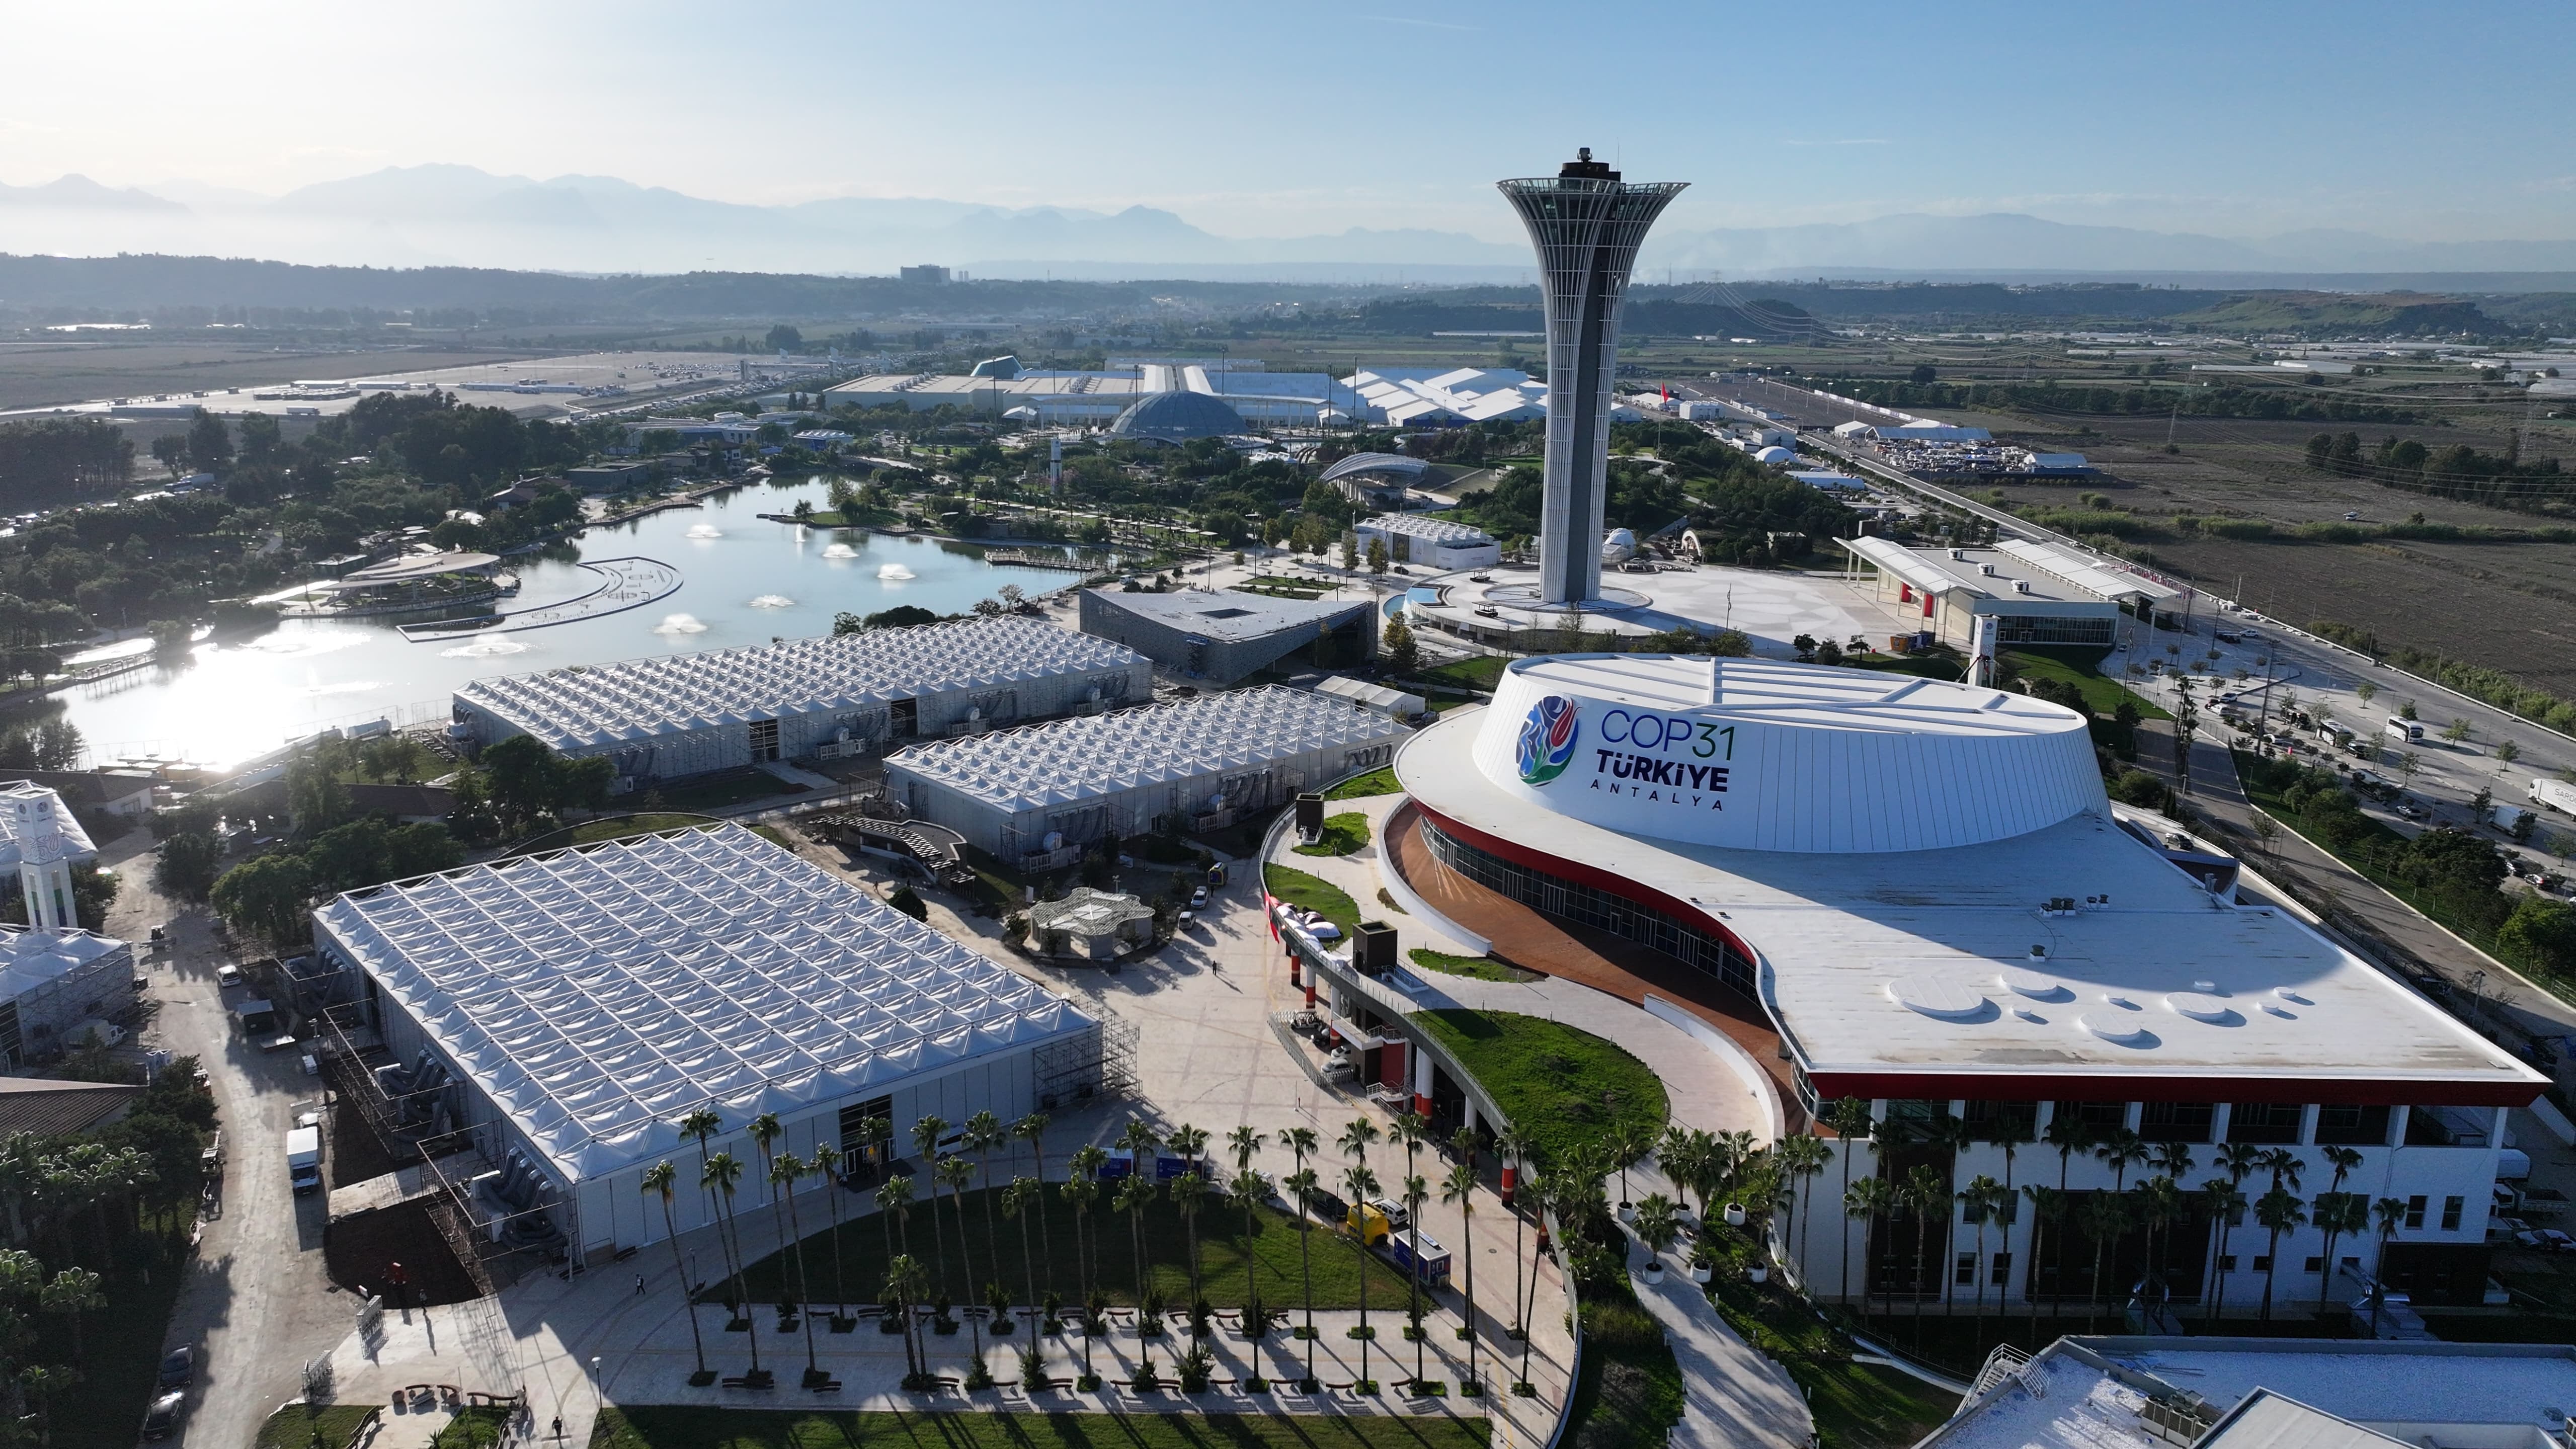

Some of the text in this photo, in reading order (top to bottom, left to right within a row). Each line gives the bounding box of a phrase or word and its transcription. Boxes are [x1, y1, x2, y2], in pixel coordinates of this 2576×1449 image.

[1601, 709, 1735, 761] COP31
[1596, 749, 1729, 793] TÜRKİYE
[1591, 779, 1723, 811] ANTALYA
